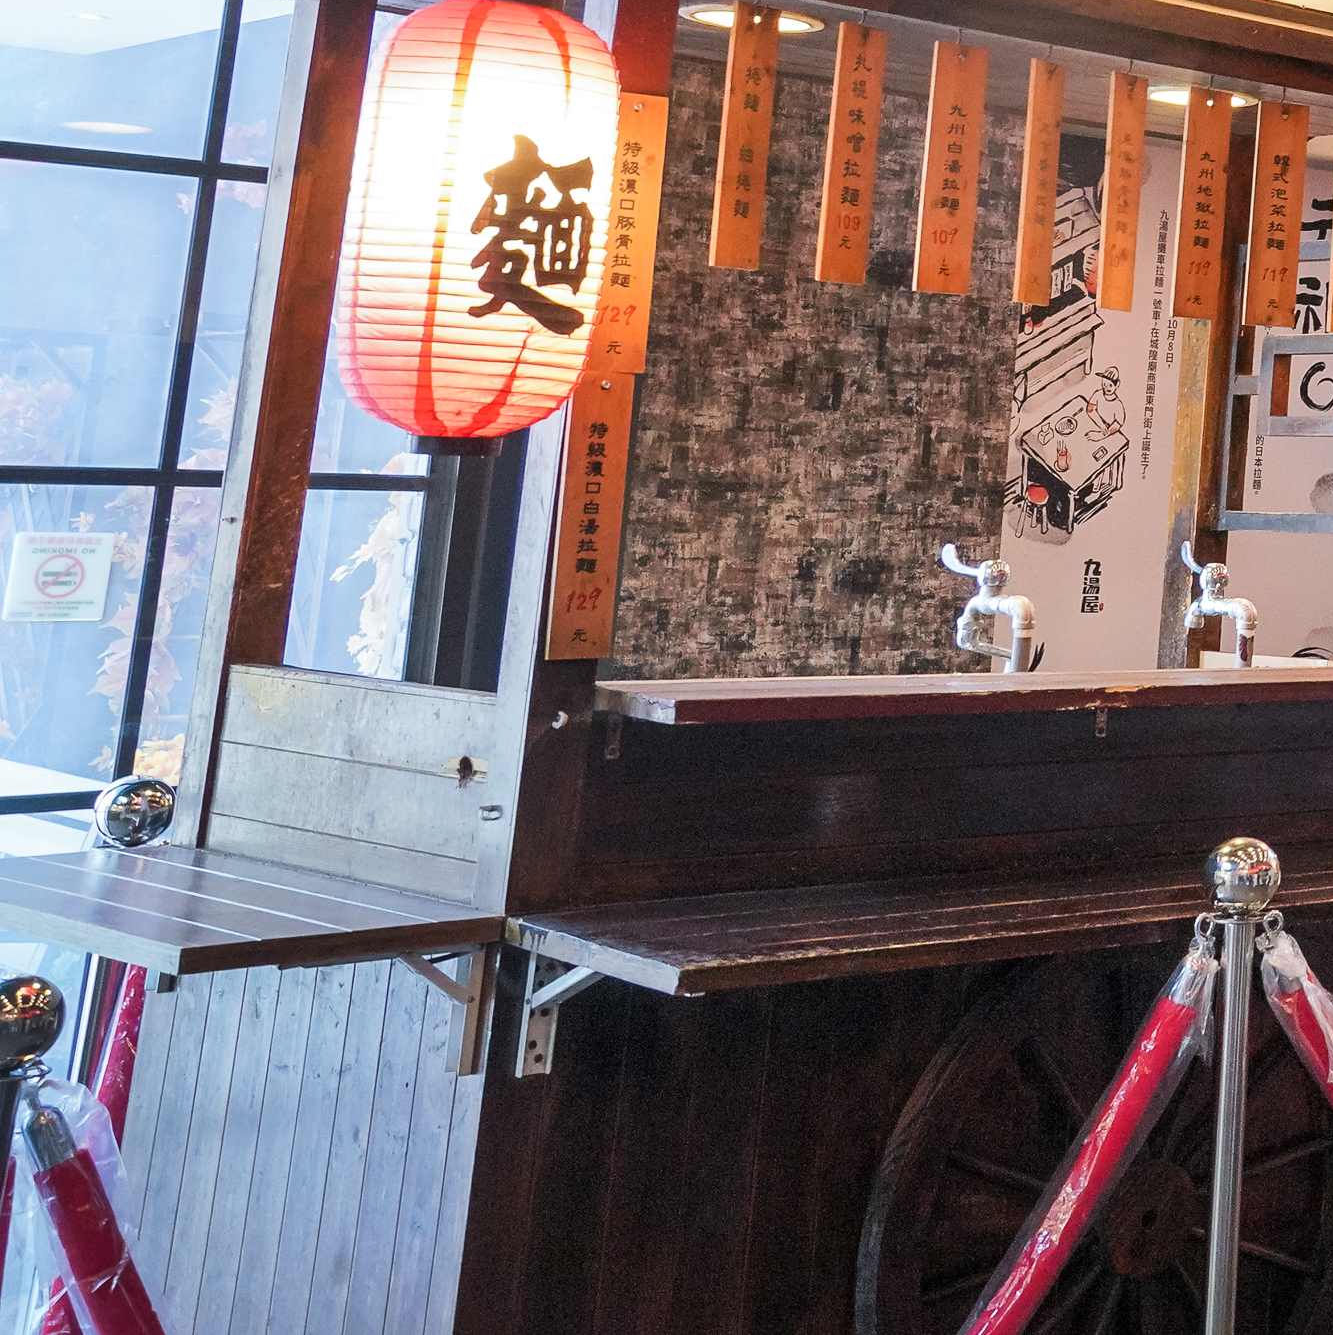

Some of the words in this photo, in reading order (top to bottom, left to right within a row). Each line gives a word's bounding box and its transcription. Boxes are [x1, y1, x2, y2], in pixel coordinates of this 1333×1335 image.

[467, 135, 594, 335] 麵
[605, 340, 622, 355] 元
[1081, 559, 1101, 613] 九湯屋
[570, 628, 588, 643] 元
